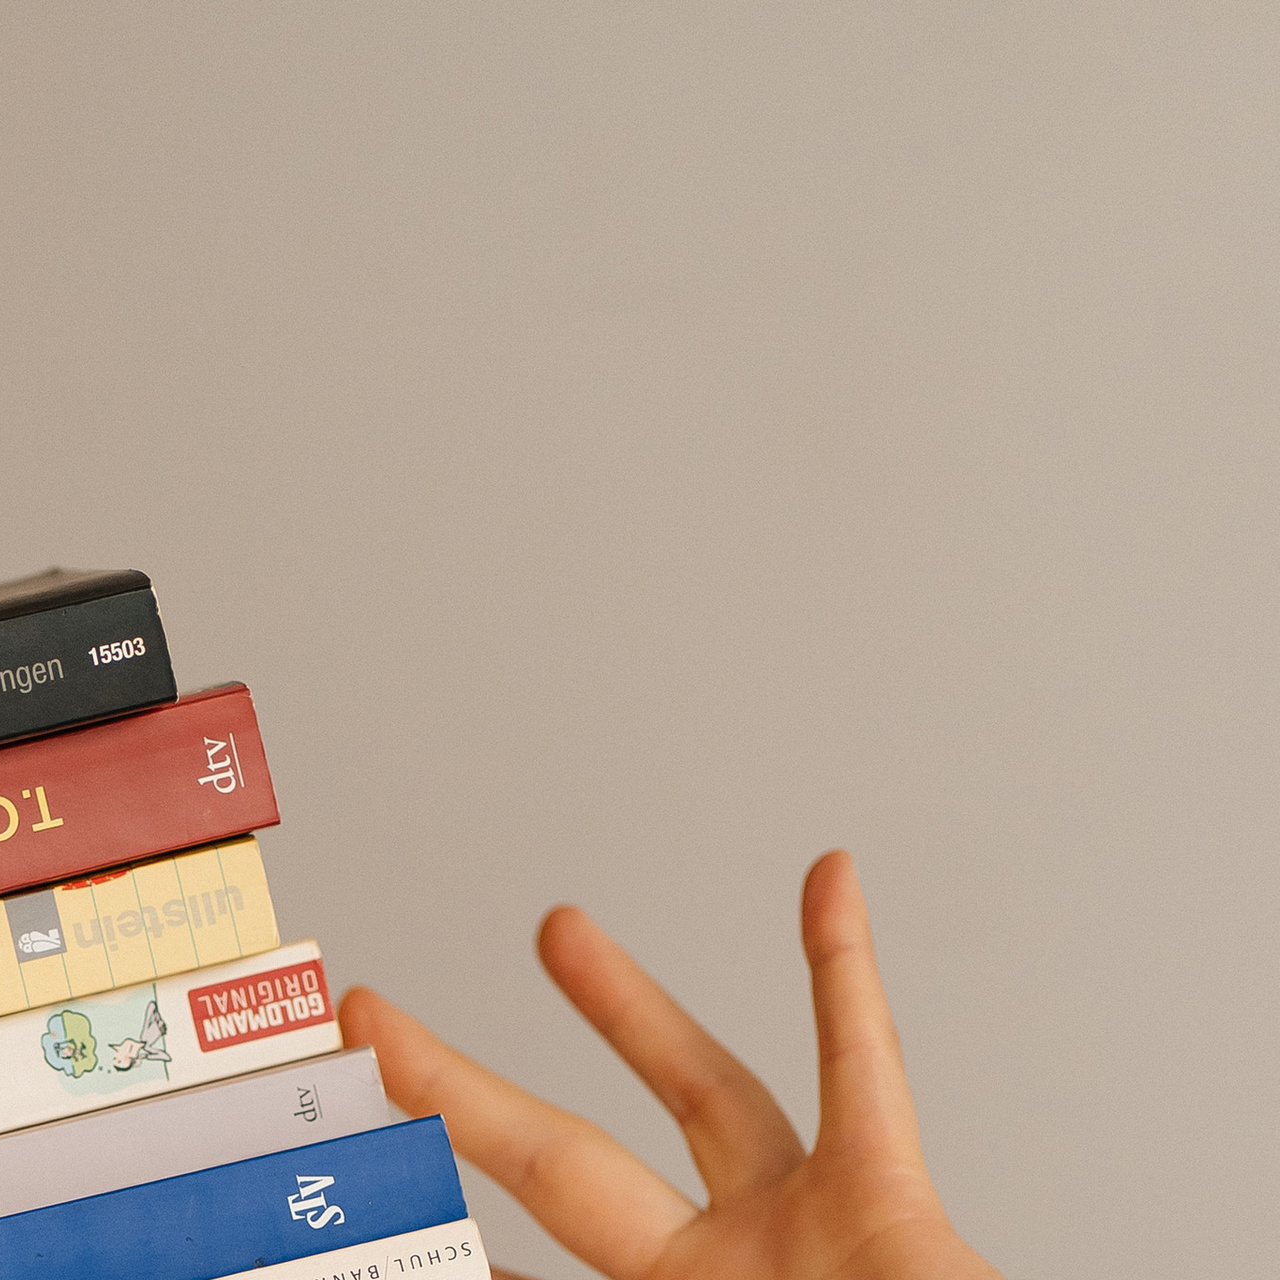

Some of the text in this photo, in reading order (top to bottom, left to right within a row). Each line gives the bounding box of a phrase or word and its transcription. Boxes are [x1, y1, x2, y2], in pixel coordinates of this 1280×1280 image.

[88, 636, 147, 667] 15503
[198, 732, 245, 795] dtv
[73, 884, 247, 950] ullstein
[197, 969, 319, 1015] ORIGINAL
[202, 993, 326, 1042] GOLDMANN
[294, 1083, 323, 1123] dtv
